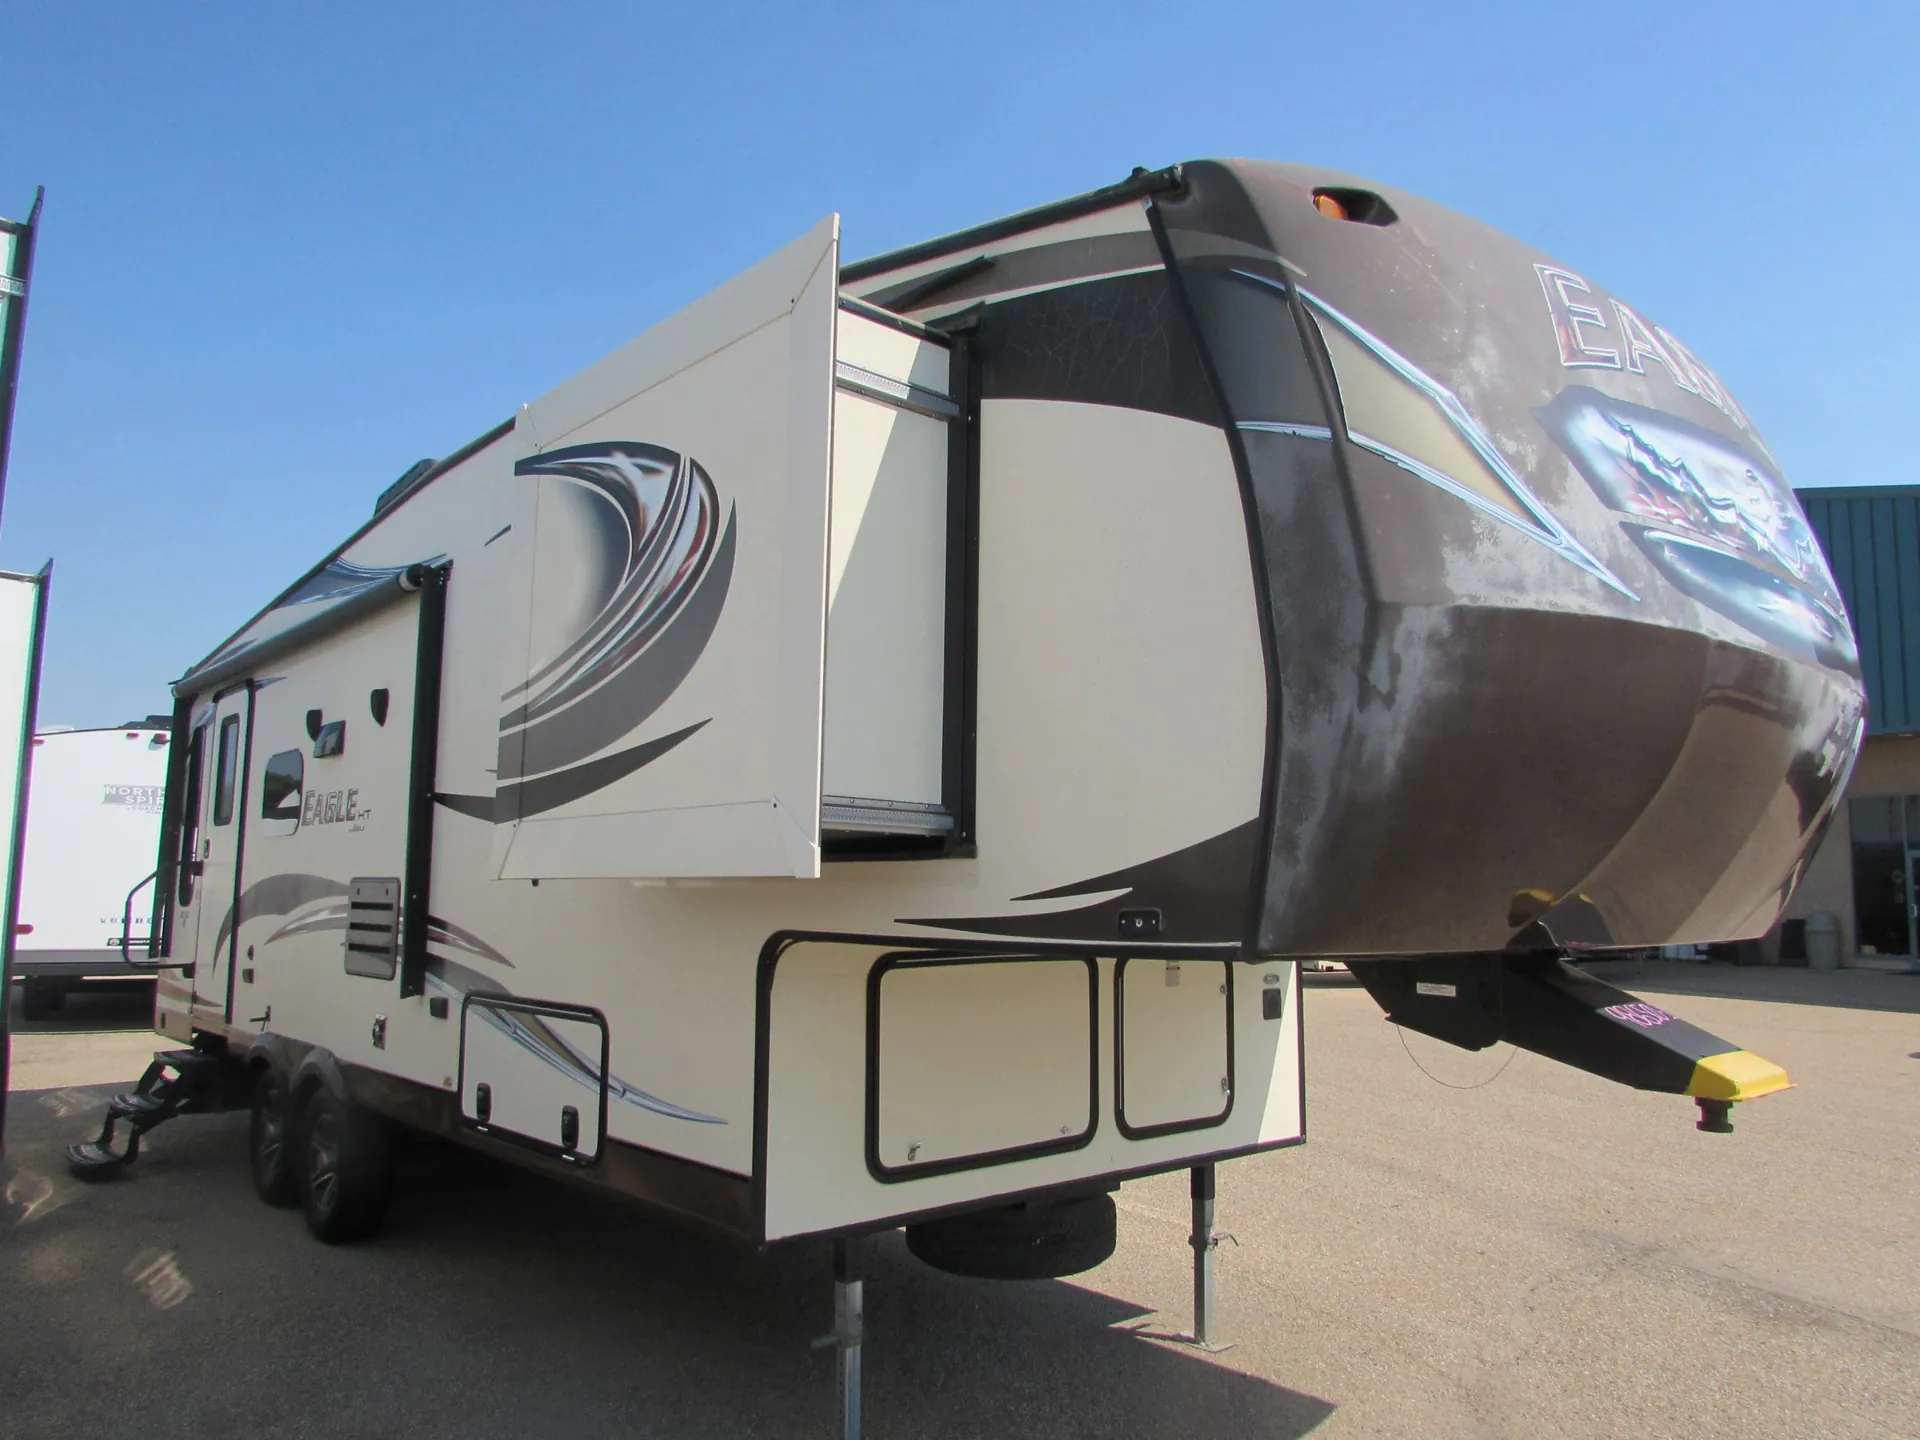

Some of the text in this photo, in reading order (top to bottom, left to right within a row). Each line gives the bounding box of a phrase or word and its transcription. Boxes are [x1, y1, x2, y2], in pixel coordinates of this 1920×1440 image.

[125, 795, 164, 805] SPIR
[301, 787, 372, 826] EAGLE HT
